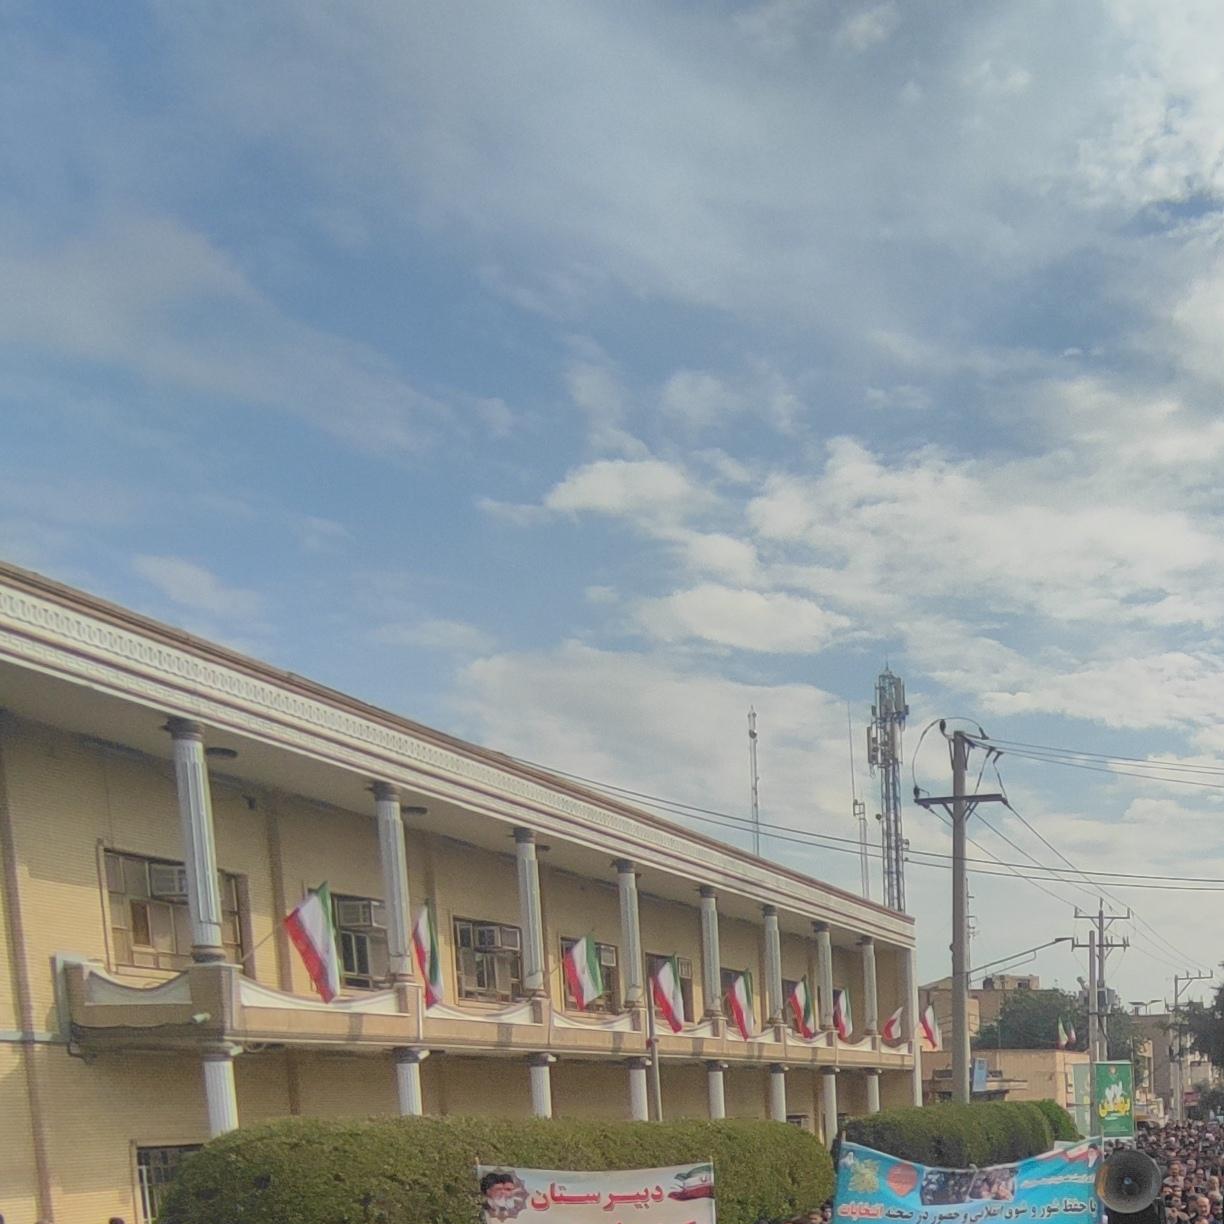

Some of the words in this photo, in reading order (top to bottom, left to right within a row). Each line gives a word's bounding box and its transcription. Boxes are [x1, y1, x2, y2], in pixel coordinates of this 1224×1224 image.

[531, 1183, 664, 1211] دبیرستان
[1031, 1205, 1037, 1218] و
[1040, 1200, 1060, 1218] شور
[1063, 1197, 1088, 1213] حفظ
[916, 1211, 929, 1224] در
[930, 1211, 960, 1224] حضور
